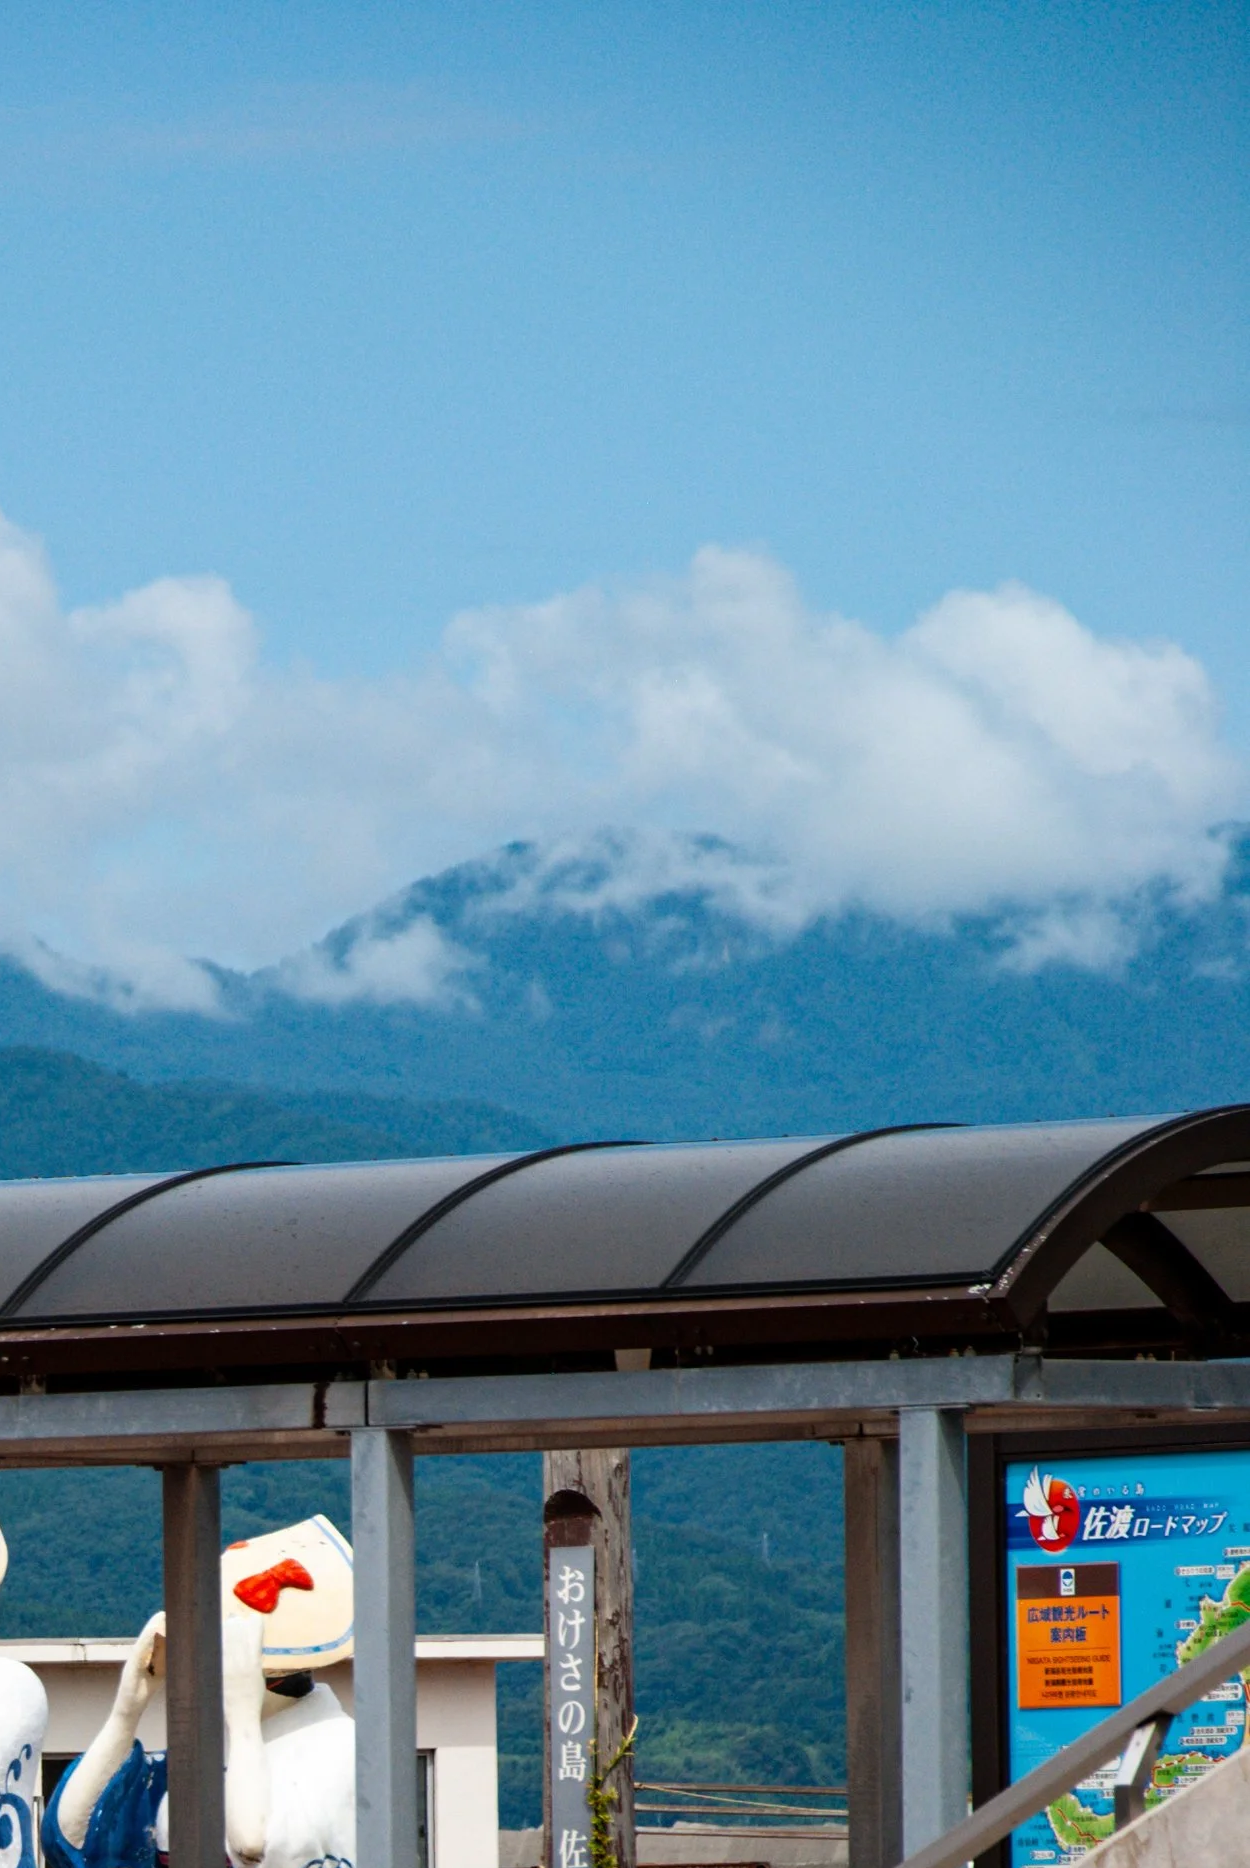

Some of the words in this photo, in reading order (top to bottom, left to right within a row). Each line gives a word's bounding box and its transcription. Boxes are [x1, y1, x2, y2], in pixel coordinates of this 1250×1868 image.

[1081, 1504, 1229, 1541] 佐渡ロードマップ
[1027, 1604, 1110, 1623] 広域観光ルート
[1050, 1626, 1087, 1643] 案内板
[557, 1565, 587, 1783] おけさの島
